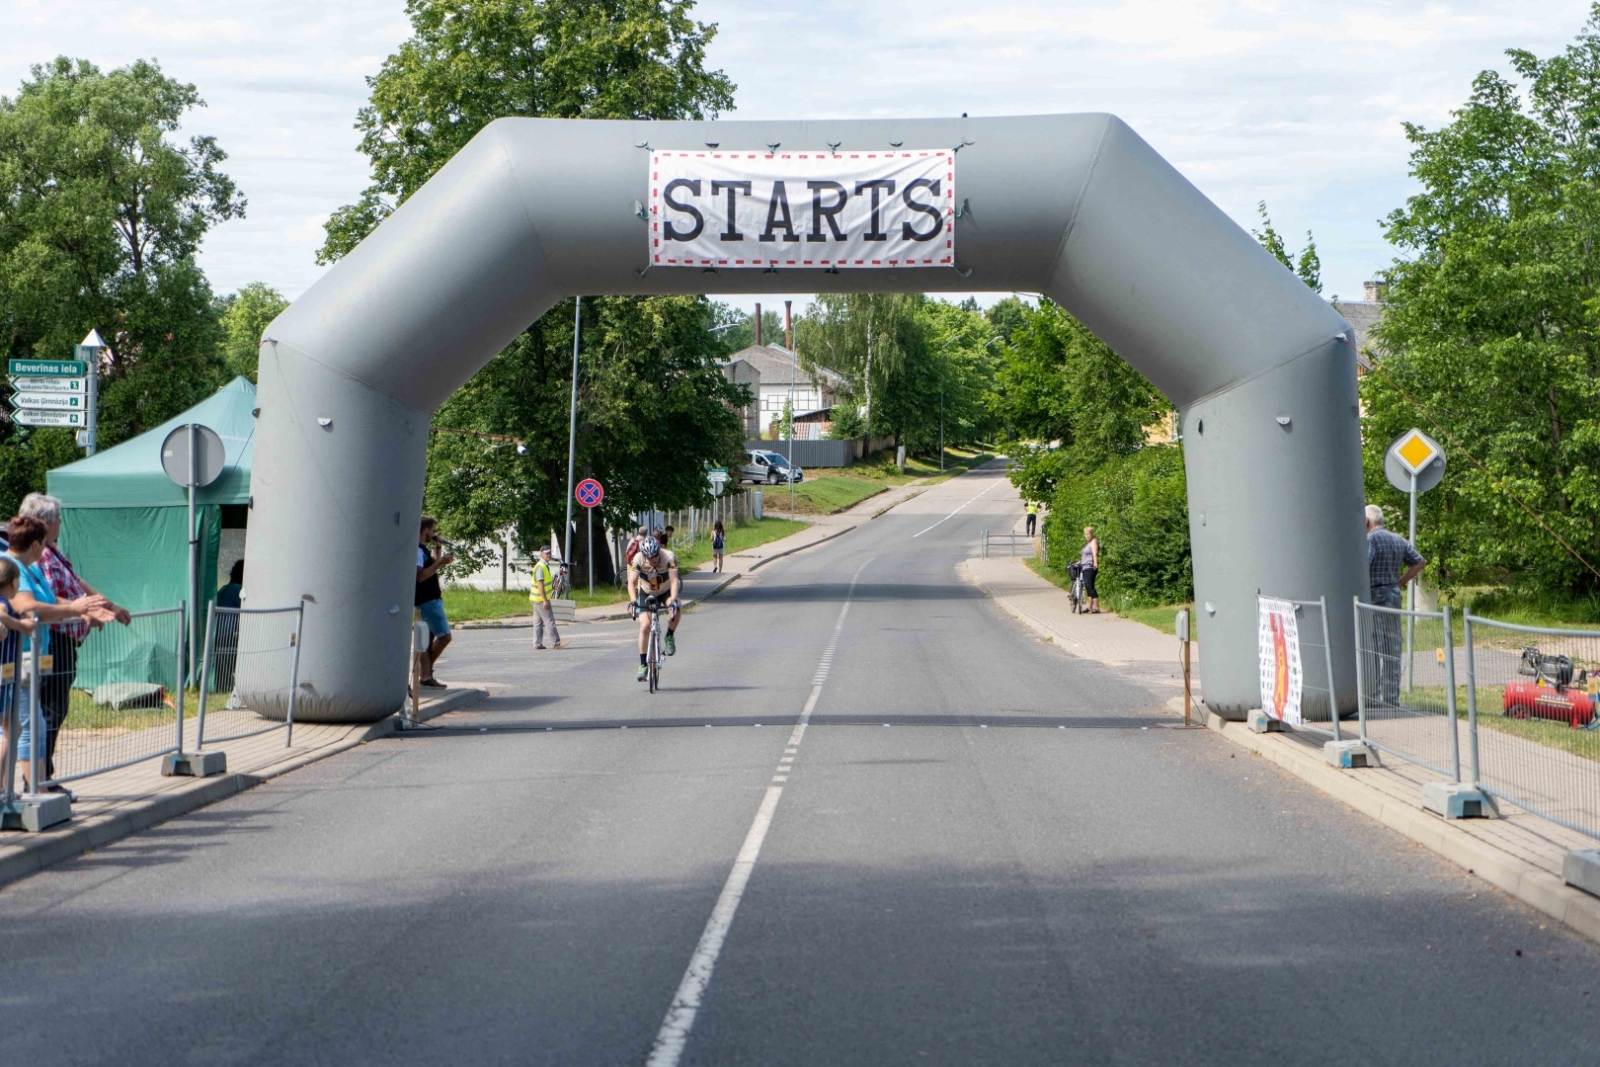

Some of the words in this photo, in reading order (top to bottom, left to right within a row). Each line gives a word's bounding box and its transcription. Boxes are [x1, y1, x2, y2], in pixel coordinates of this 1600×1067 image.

[663, 178, 944, 242] STARTS
[16, 363, 59, 373] Beverīnas
[61, 364, 77, 373] iela
